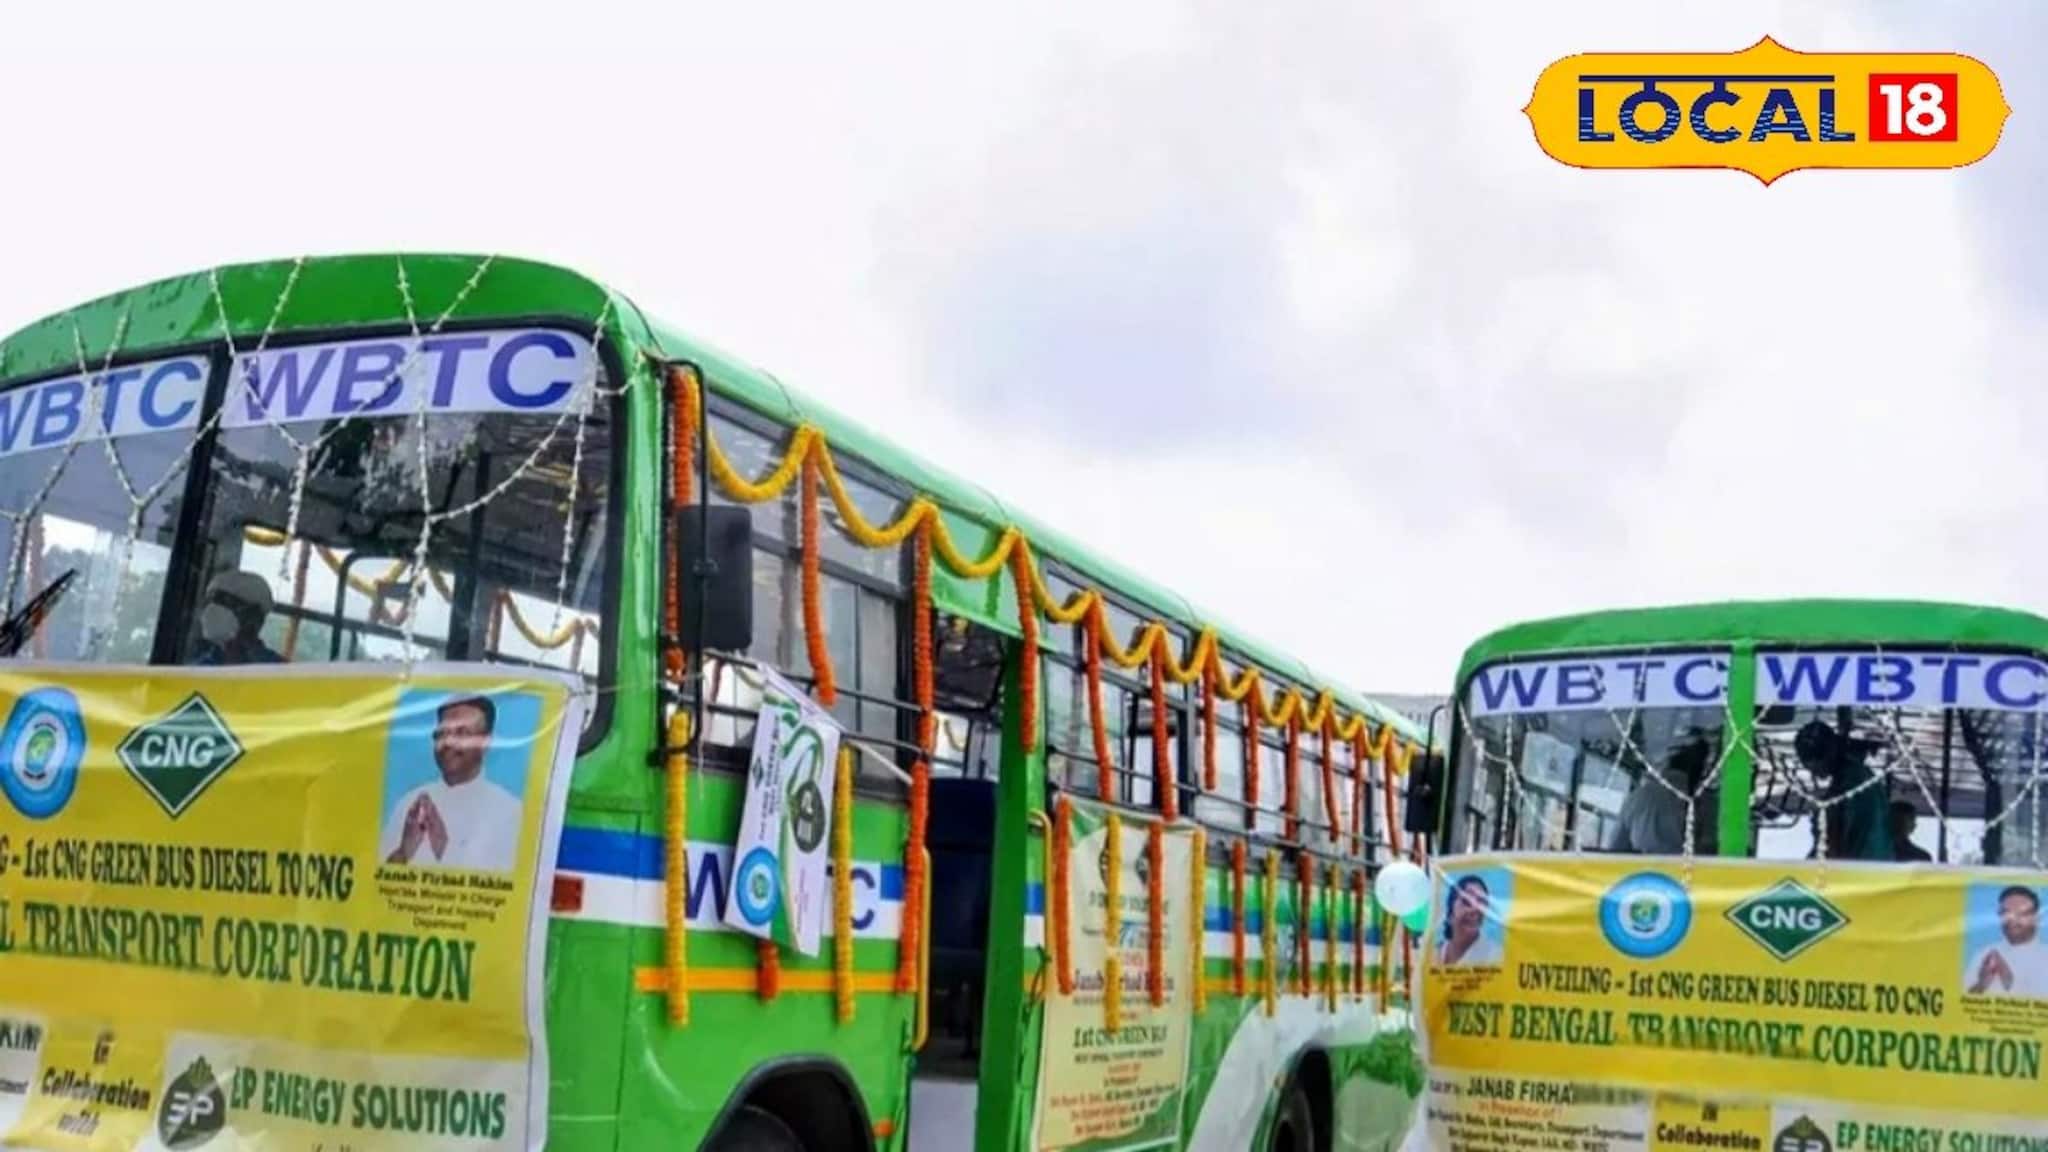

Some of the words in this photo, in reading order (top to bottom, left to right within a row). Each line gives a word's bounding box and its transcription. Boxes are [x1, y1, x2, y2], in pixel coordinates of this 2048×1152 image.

[241, 332, 575, 419] WBTC
[1476, 660, 1727, 709] WBTC
[1765, 656, 2047, 708] WBTC
[141, 735, 215, 768] CNG
[23, 838, 48, 877] 1st
[53, 838, 87, 879] CNG
[91, 841, 151, 885] GREEN
[156, 845, 194, 891] BUS
[199, 848, 271, 894] DIESEL
[277, 852, 300, 899] TO
[304, 853, 354, 901] CNG
[1750, 904, 1821, 932] CNG
[24, 901, 203, 970] TRANSPORT
[213, 916, 475, 1002] CORPORATION
[1518, 962, 1612, 995] UNVEILING
[1628, 971, 1653, 998] 1st
[1656, 972, 1693, 1000] CNG
[1698, 974, 1759, 1004] GREEN
[1764, 977, 1800, 1007] BUS
[1804, 980, 1868, 1012] DIESEL
[1874, 985, 1900, 1014] TO
[1903, 987, 1944, 1017] CNG
[1448, 1001, 1504, 1039] WEST
[1509, 1004, 1618, 1047] BENGAL
[1813, 1024, 2043, 1081] CORPORATION
[262, 1069, 347, 1125] ENERGY
[351, 1082, 507, 1140] SOLUTIONS
[1467, 1075, 1515, 1101] JANAB
[1519, 1080, 1578, 1106] FIRHA
[1657, 1121, 1762, 1151] Collaboration
[1837, 1121, 1859, 1149] EP
[1866, 1123, 1943, 1152] ENERGY
